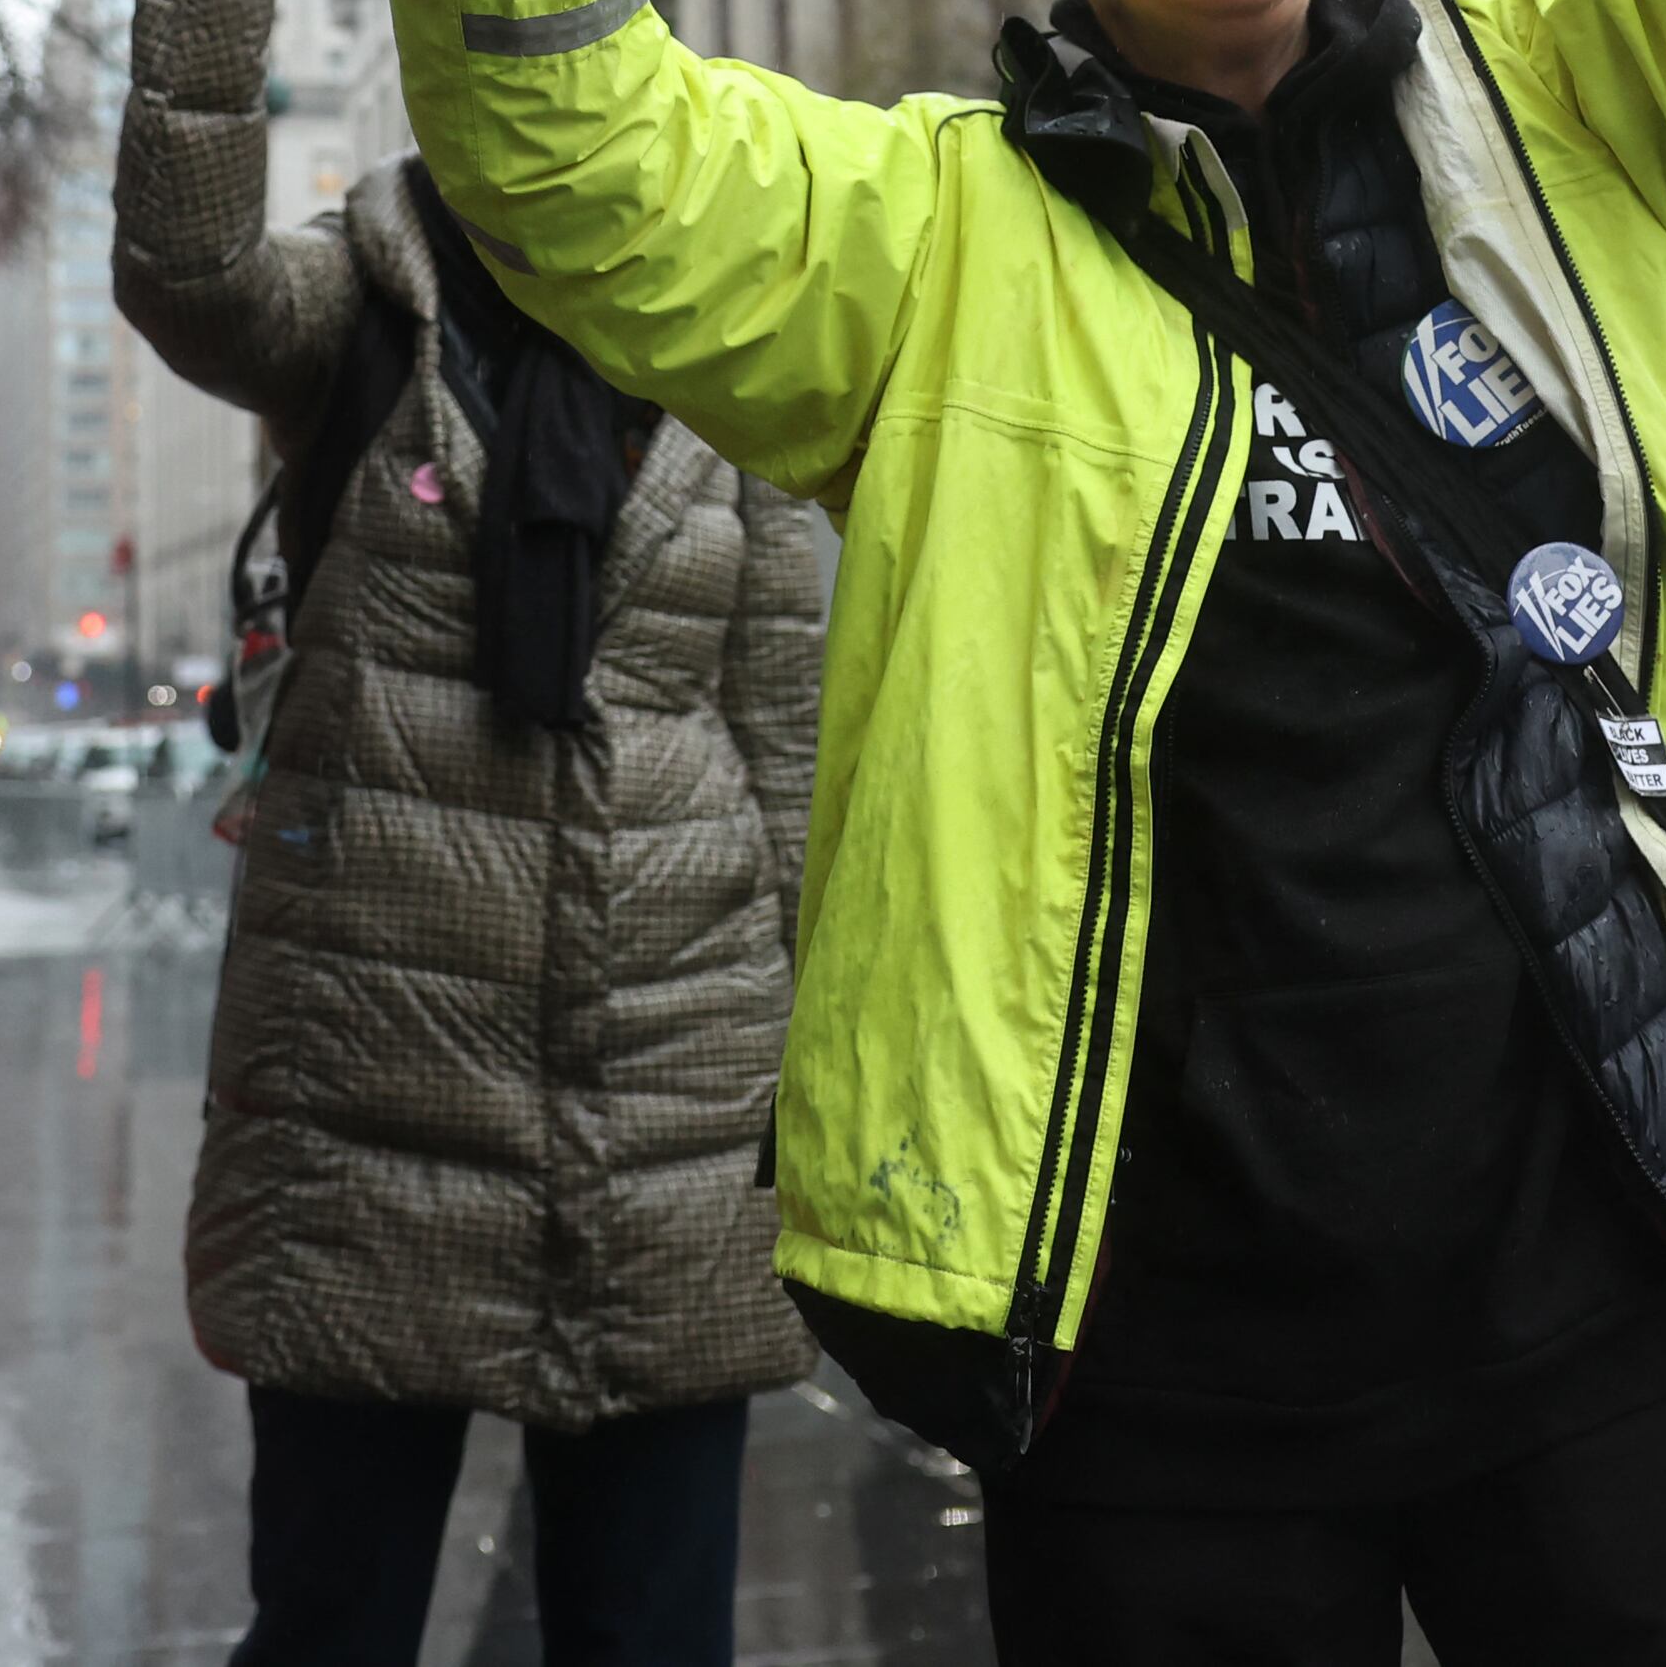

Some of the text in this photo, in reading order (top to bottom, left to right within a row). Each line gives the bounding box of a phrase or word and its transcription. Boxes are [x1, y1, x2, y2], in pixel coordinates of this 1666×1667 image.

[1431, 322, 1502, 386] FO
[1438, 356, 1537, 448] LIE
[1224, 479, 1372, 542] RA
[1543, 555, 1599, 617] FOX
[1554, 575, 1623, 655] LIES
